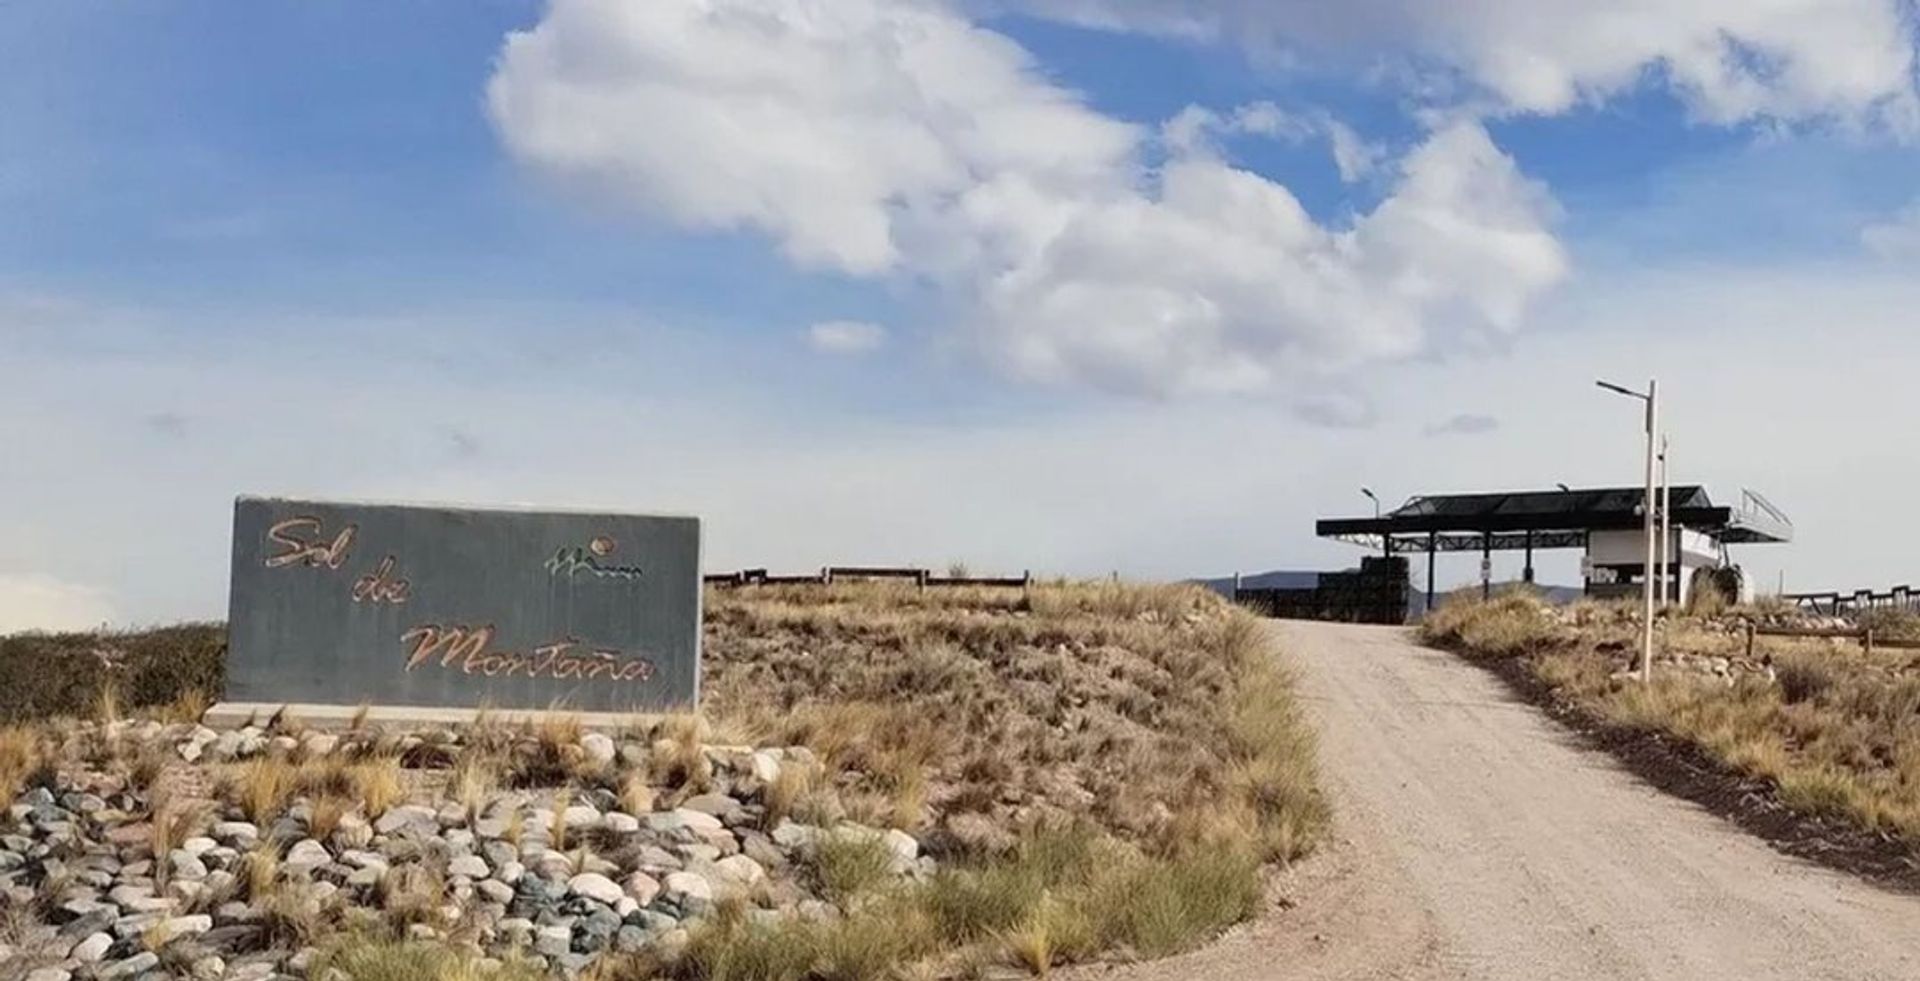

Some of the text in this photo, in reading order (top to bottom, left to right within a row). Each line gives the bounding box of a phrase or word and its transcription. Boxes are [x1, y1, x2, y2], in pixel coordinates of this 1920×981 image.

[265, 516, 357, 569] Sol
[353, 556, 409, 602] de
[400, 624, 656, 681] Montaña
